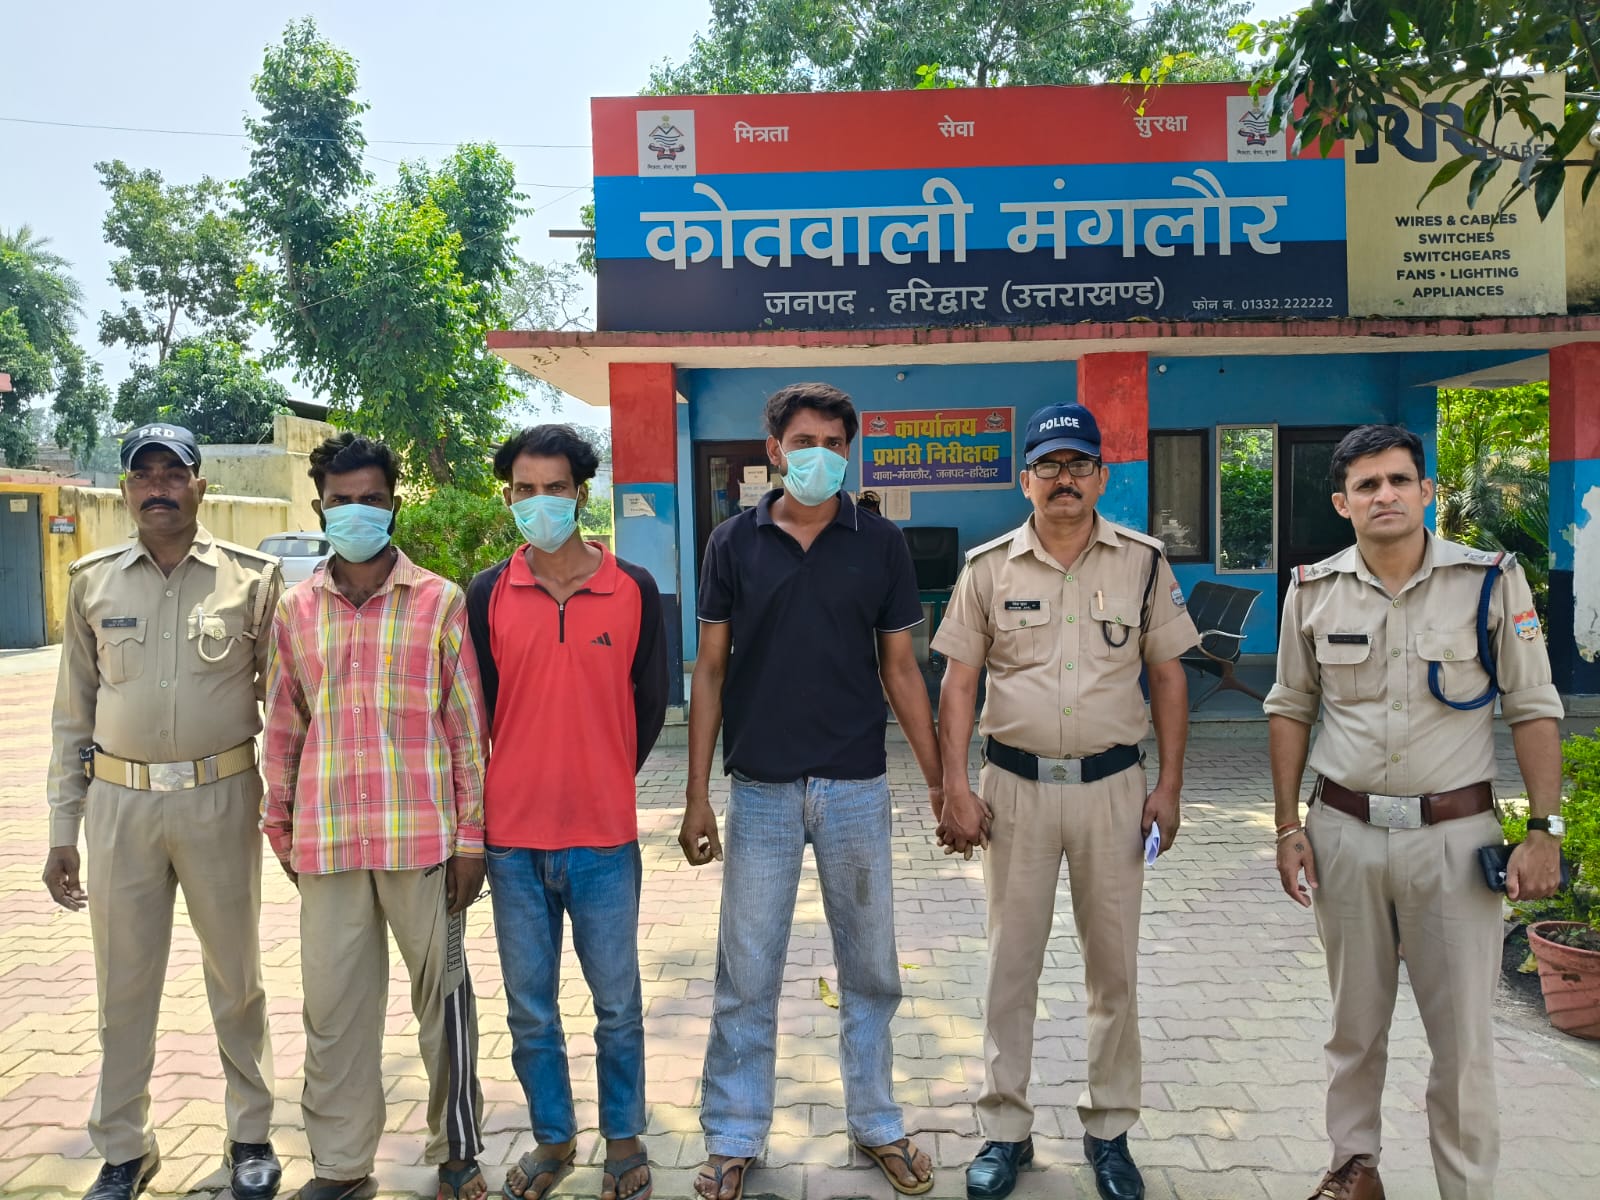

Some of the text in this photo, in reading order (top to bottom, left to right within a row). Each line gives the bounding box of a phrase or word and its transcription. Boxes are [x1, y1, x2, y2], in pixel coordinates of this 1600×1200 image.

[733, 121, 790, 143] मित्रता
[937, 114, 975, 138] सेवा
[1133, 114, 1188, 138] सुरक्षा
[639, 168, 1288, 270] कोतवाली मंगलौर
[1395, 213, 1518, 227] WIRES & CABLES
[1418, 232, 1495, 244] SWITCHES
[1403, 249, 1511, 262] SWITCHGEARS
[1396, 266, 1519, 281] FANS LIGHTING
[763, 275, 1165, 315] जनपद हरिद्वार (उत्तराखण्ड)
[1412, 285, 1505, 298] APPLIANCES
[1192, 296, 1219, 310] फोन
[1241, 297, 1334, 310] 01332.222222
[894, 412, 978, 439] कार्यालय
[1039, 416, 1080, 432] POLICE
[138, 427, 175, 438] PRD
[872, 441, 1000, 467] प्रभारी निरीक्षक
